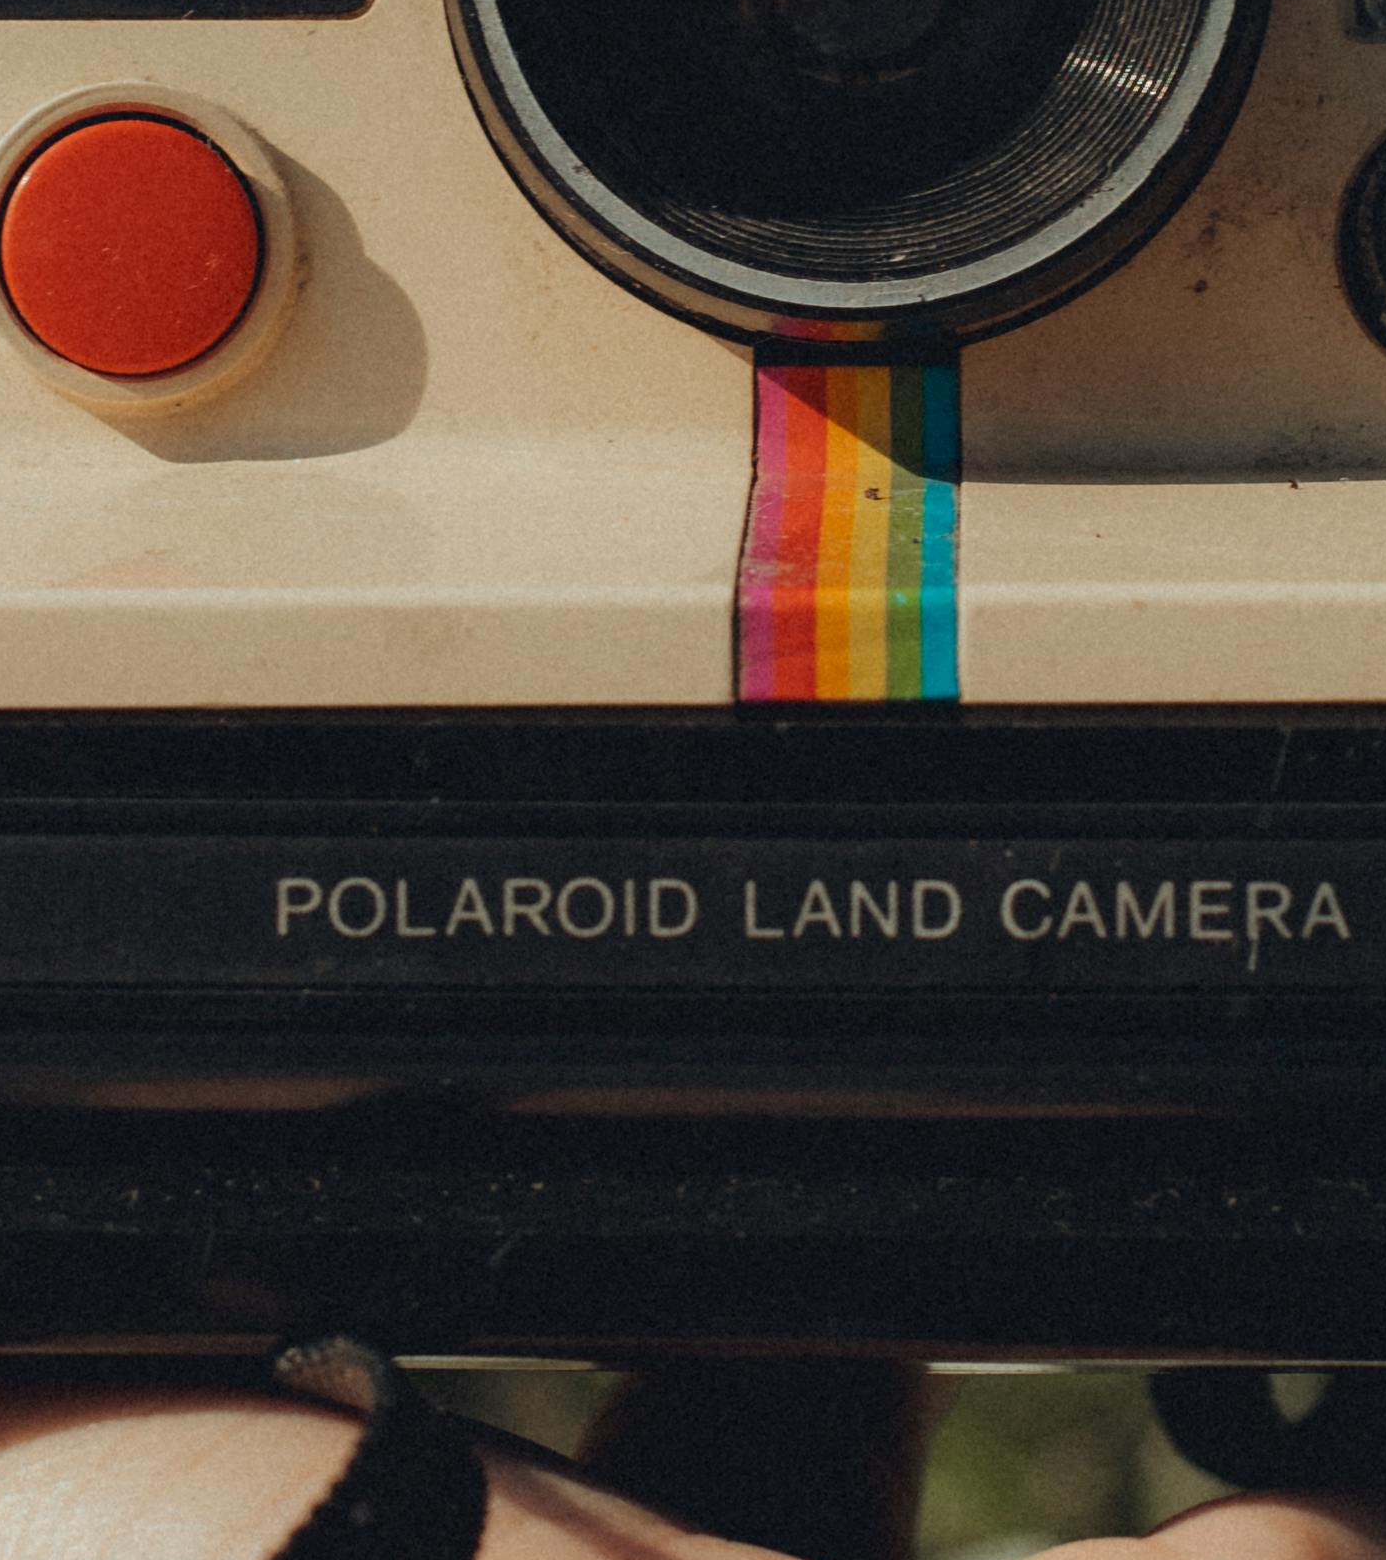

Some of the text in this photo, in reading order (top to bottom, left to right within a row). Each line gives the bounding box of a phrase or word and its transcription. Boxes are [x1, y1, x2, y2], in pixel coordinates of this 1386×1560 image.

[276, 876, 1353, 941] POLAROID LAND CAMERA
